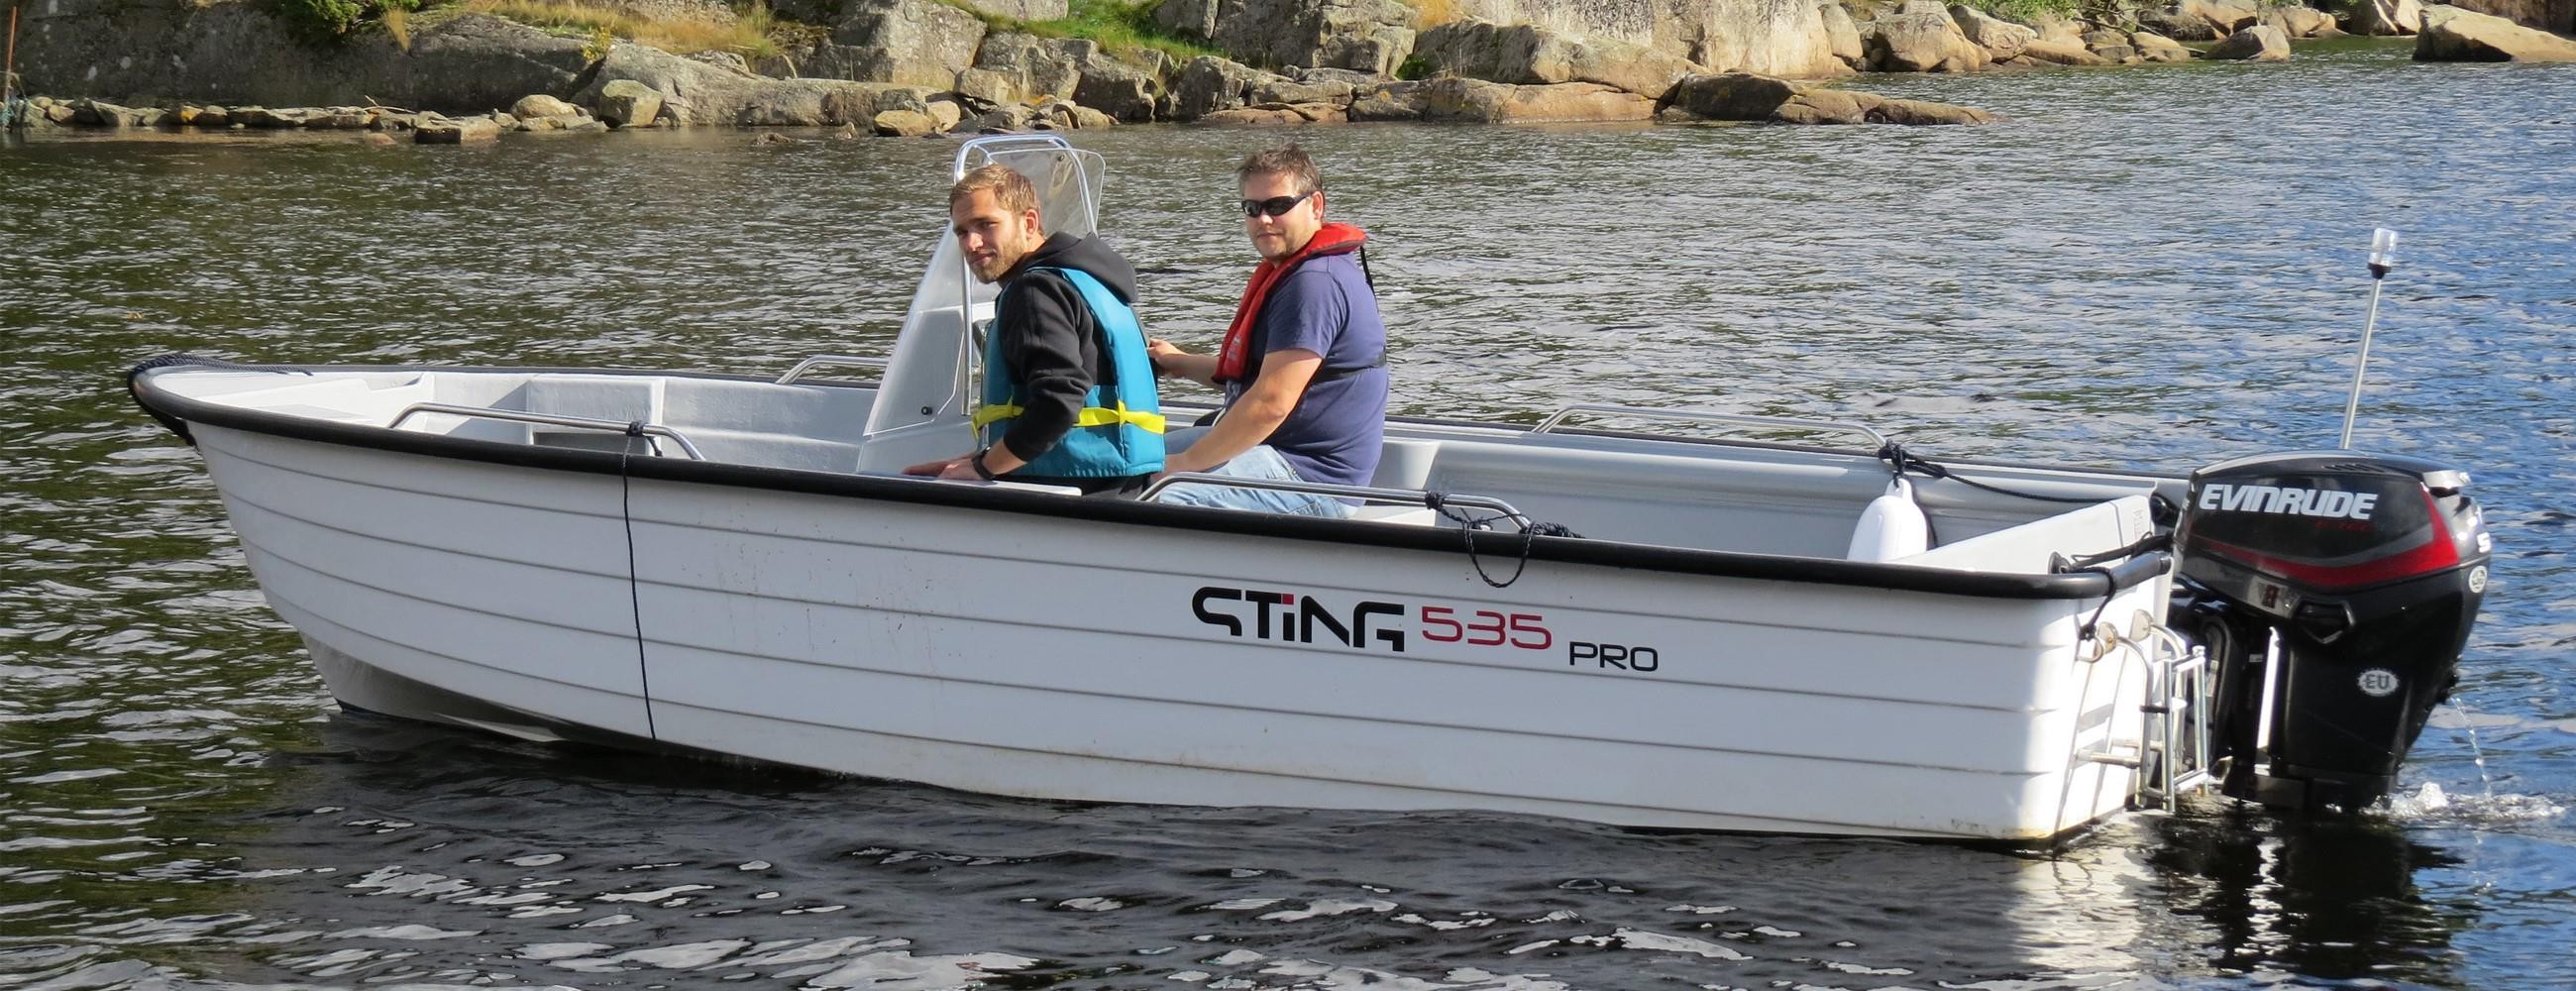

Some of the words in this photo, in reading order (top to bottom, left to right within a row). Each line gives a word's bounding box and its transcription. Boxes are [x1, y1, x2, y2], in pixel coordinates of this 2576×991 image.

[2199, 483, 2380, 520] EVINRUDE
[1423, 606, 1554, 651] 535
[1569, 641, 1660, 673] PRO
